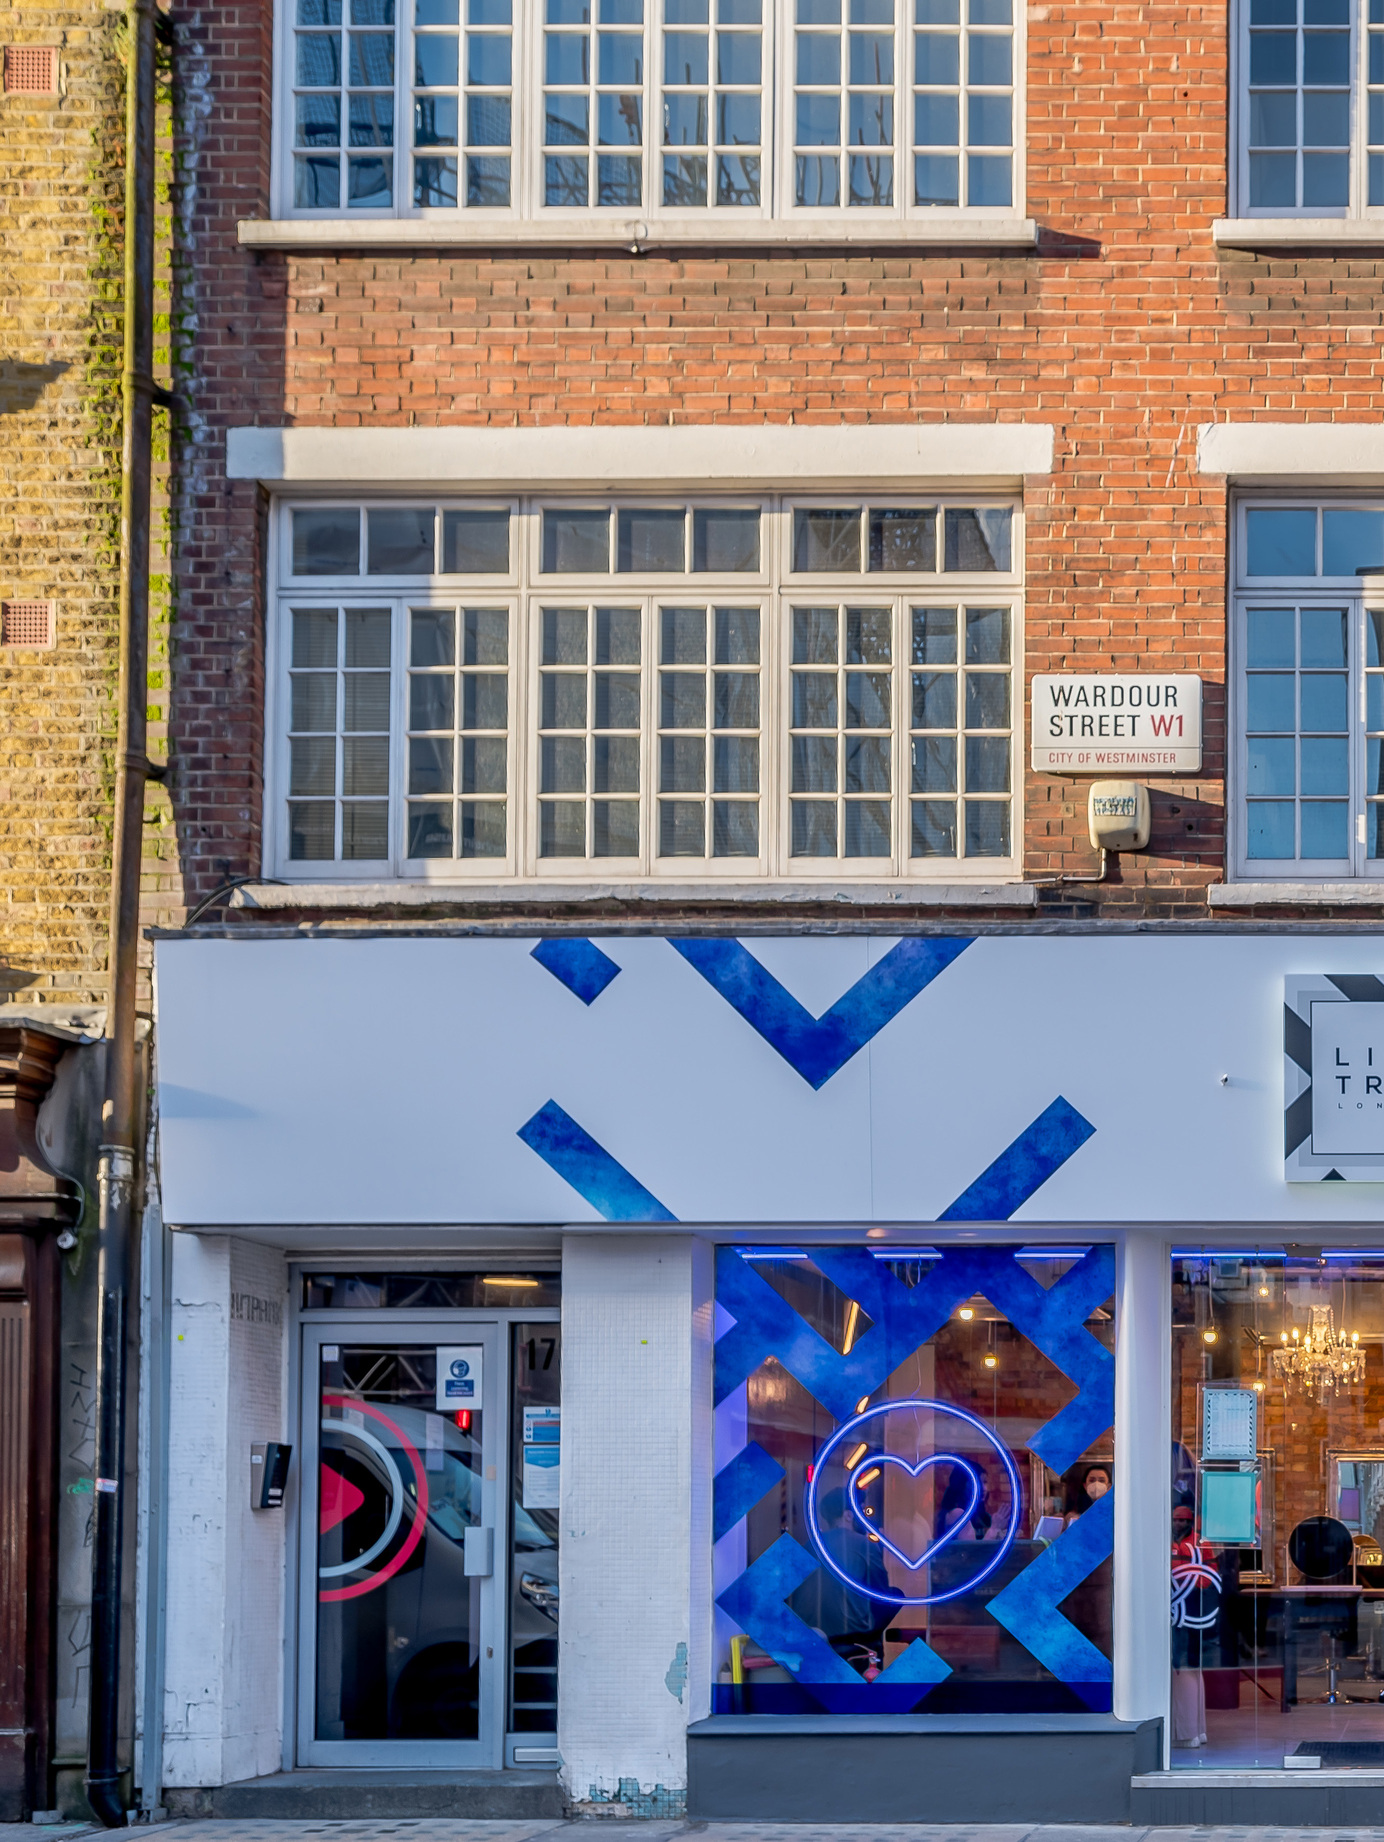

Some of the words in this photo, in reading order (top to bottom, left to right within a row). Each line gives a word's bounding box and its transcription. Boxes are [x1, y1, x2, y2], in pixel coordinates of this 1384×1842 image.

[1049, 685, 1178, 707] WARDOUR
[1049, 714, 1141, 737] STREET
[1150, 714, 1184, 737] W1
[1048, 752, 1075, 763] CITY
[1078, 752, 1092, 763] OF
[1095, 752, 1176, 763] WESTMINSTER
[527, 1337, 556, 1371] 17
